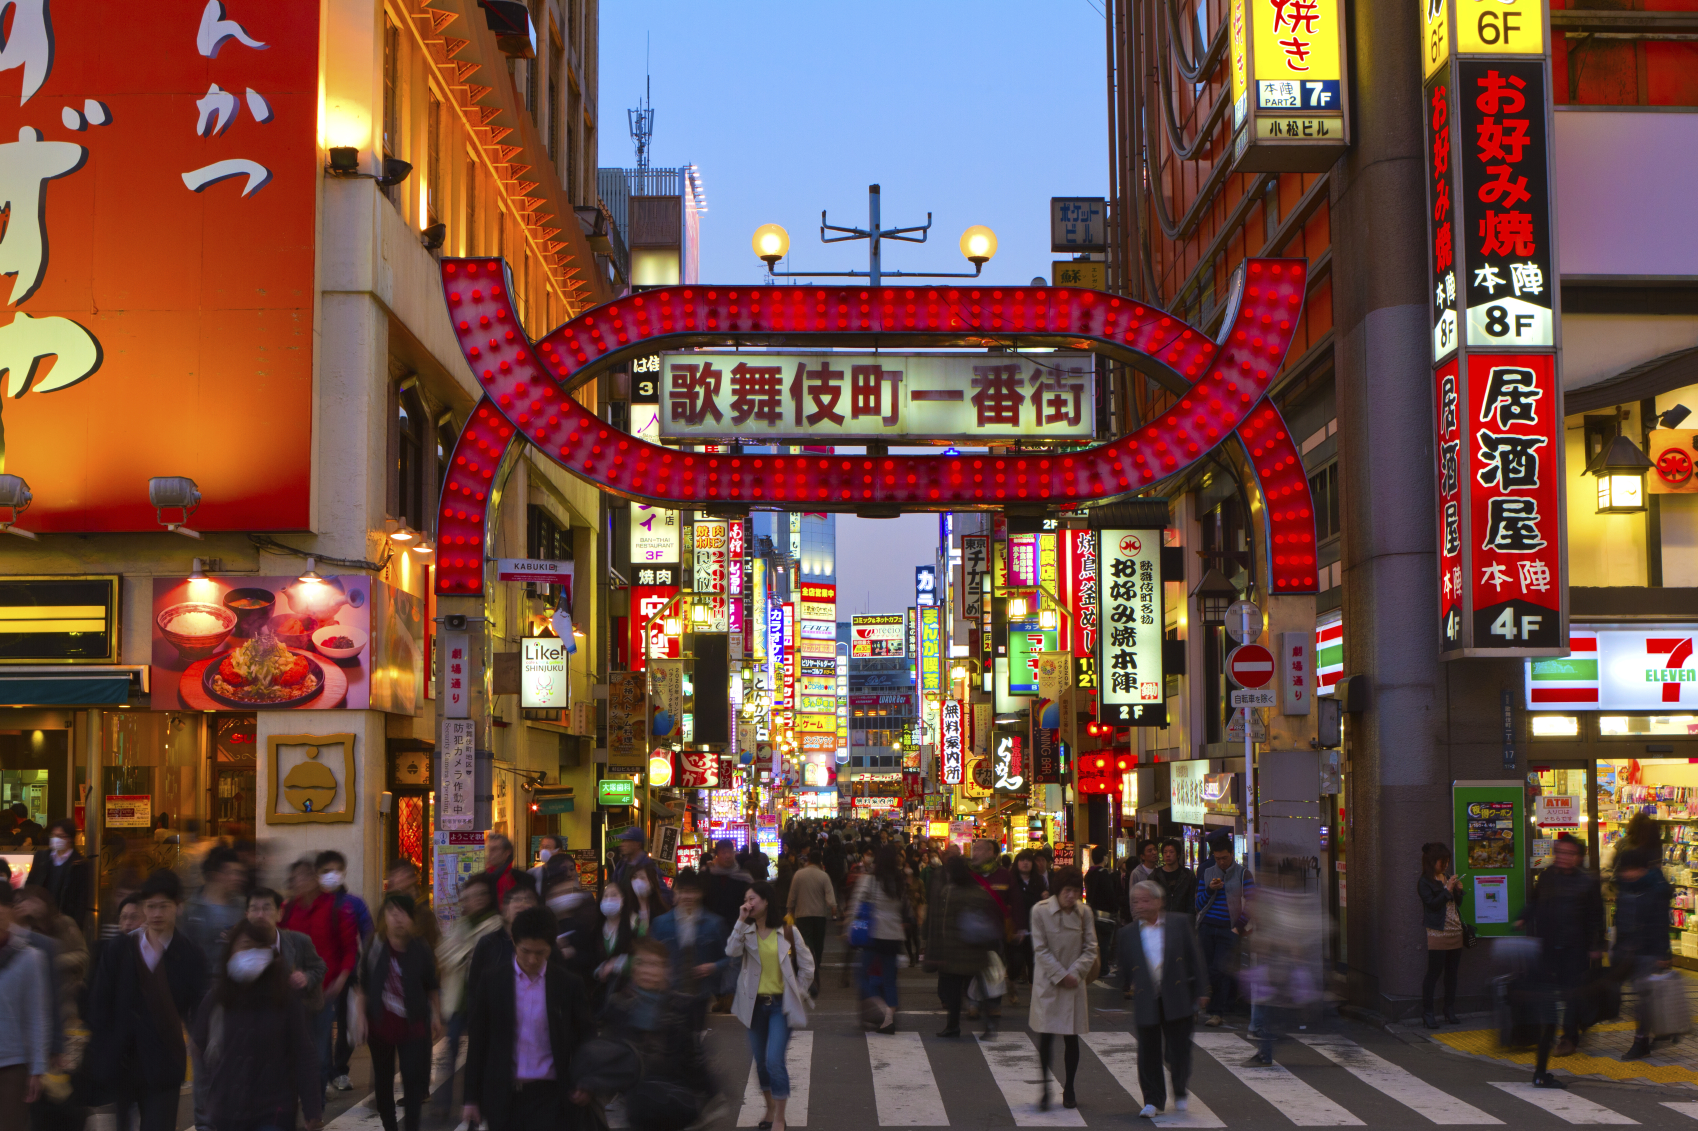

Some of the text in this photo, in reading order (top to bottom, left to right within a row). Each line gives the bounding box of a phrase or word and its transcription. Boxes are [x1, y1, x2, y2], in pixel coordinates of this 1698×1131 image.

[1431, 22, 1444, 64] 6F
[1477, 10, 1523, 45] 6F
[1264, 82, 1294, 97] 本陣
[1264, 95, 1298, 107] PART2
[1305, 81, 1333, 107] 7F
[1269, 120, 1330, 138] 小松ビル
[1475, 69, 1536, 258] お好み焼
[1431, 85, 1453, 275] お好み焼
[1060, 202, 1100, 223] ポケット
[1065, 222, 1094, 244] ビル
[1435, 269, 1457, 311] 本陣
[1474, 260, 1544, 297] 本陣
[1440, 317, 1455, 349] 8F
[1485, 305, 1535, 338] 8F
[668, 361, 1086, 428] 歌舞伎町一番街
[1440, 374, 1461, 558] 居酒屋
[1475, 366, 1549, 554] 居酒屋
[696, 525, 726, 538] 焼肉
[1042, 518, 1058, 530] 2F
[645, 550, 664, 561] 3F
[639, 568, 672, 585] 焼肉
[1443, 562, 1463, 601] 本陣
[1480, 558, 1551, 594] 本陣
[1109, 558, 1139, 694] お好み焼本陣
[1446, 610, 1461, 642] 4F
[1490, 607, 1543, 641] 4F
[526, 641, 564, 660] Like!
[922, 608, 939, 689] まんが喫茶
[451, 648, 463, 704] 劇場通り
[525, 664, 564, 673] SHINJUKU
[1292, 645, 1304, 701] 劇場通り
[1119, 705, 1143, 720] 2F
[1234, 693, 1274, 705] 自転車を除く
[802, 719, 824, 729] ゲーム
[465, 722, 474, 768] 歌舞伎町地区
[944, 703, 959, 781] 無料案内所
[1504, 750, 1515, 759] 17
[453, 723, 464, 815] 防犯カメラ作動中
[1041, 758, 1052, 775] BAR
[601, 782, 631, 792] 大塚歯科
[1545, 798, 1571, 807] ATM
